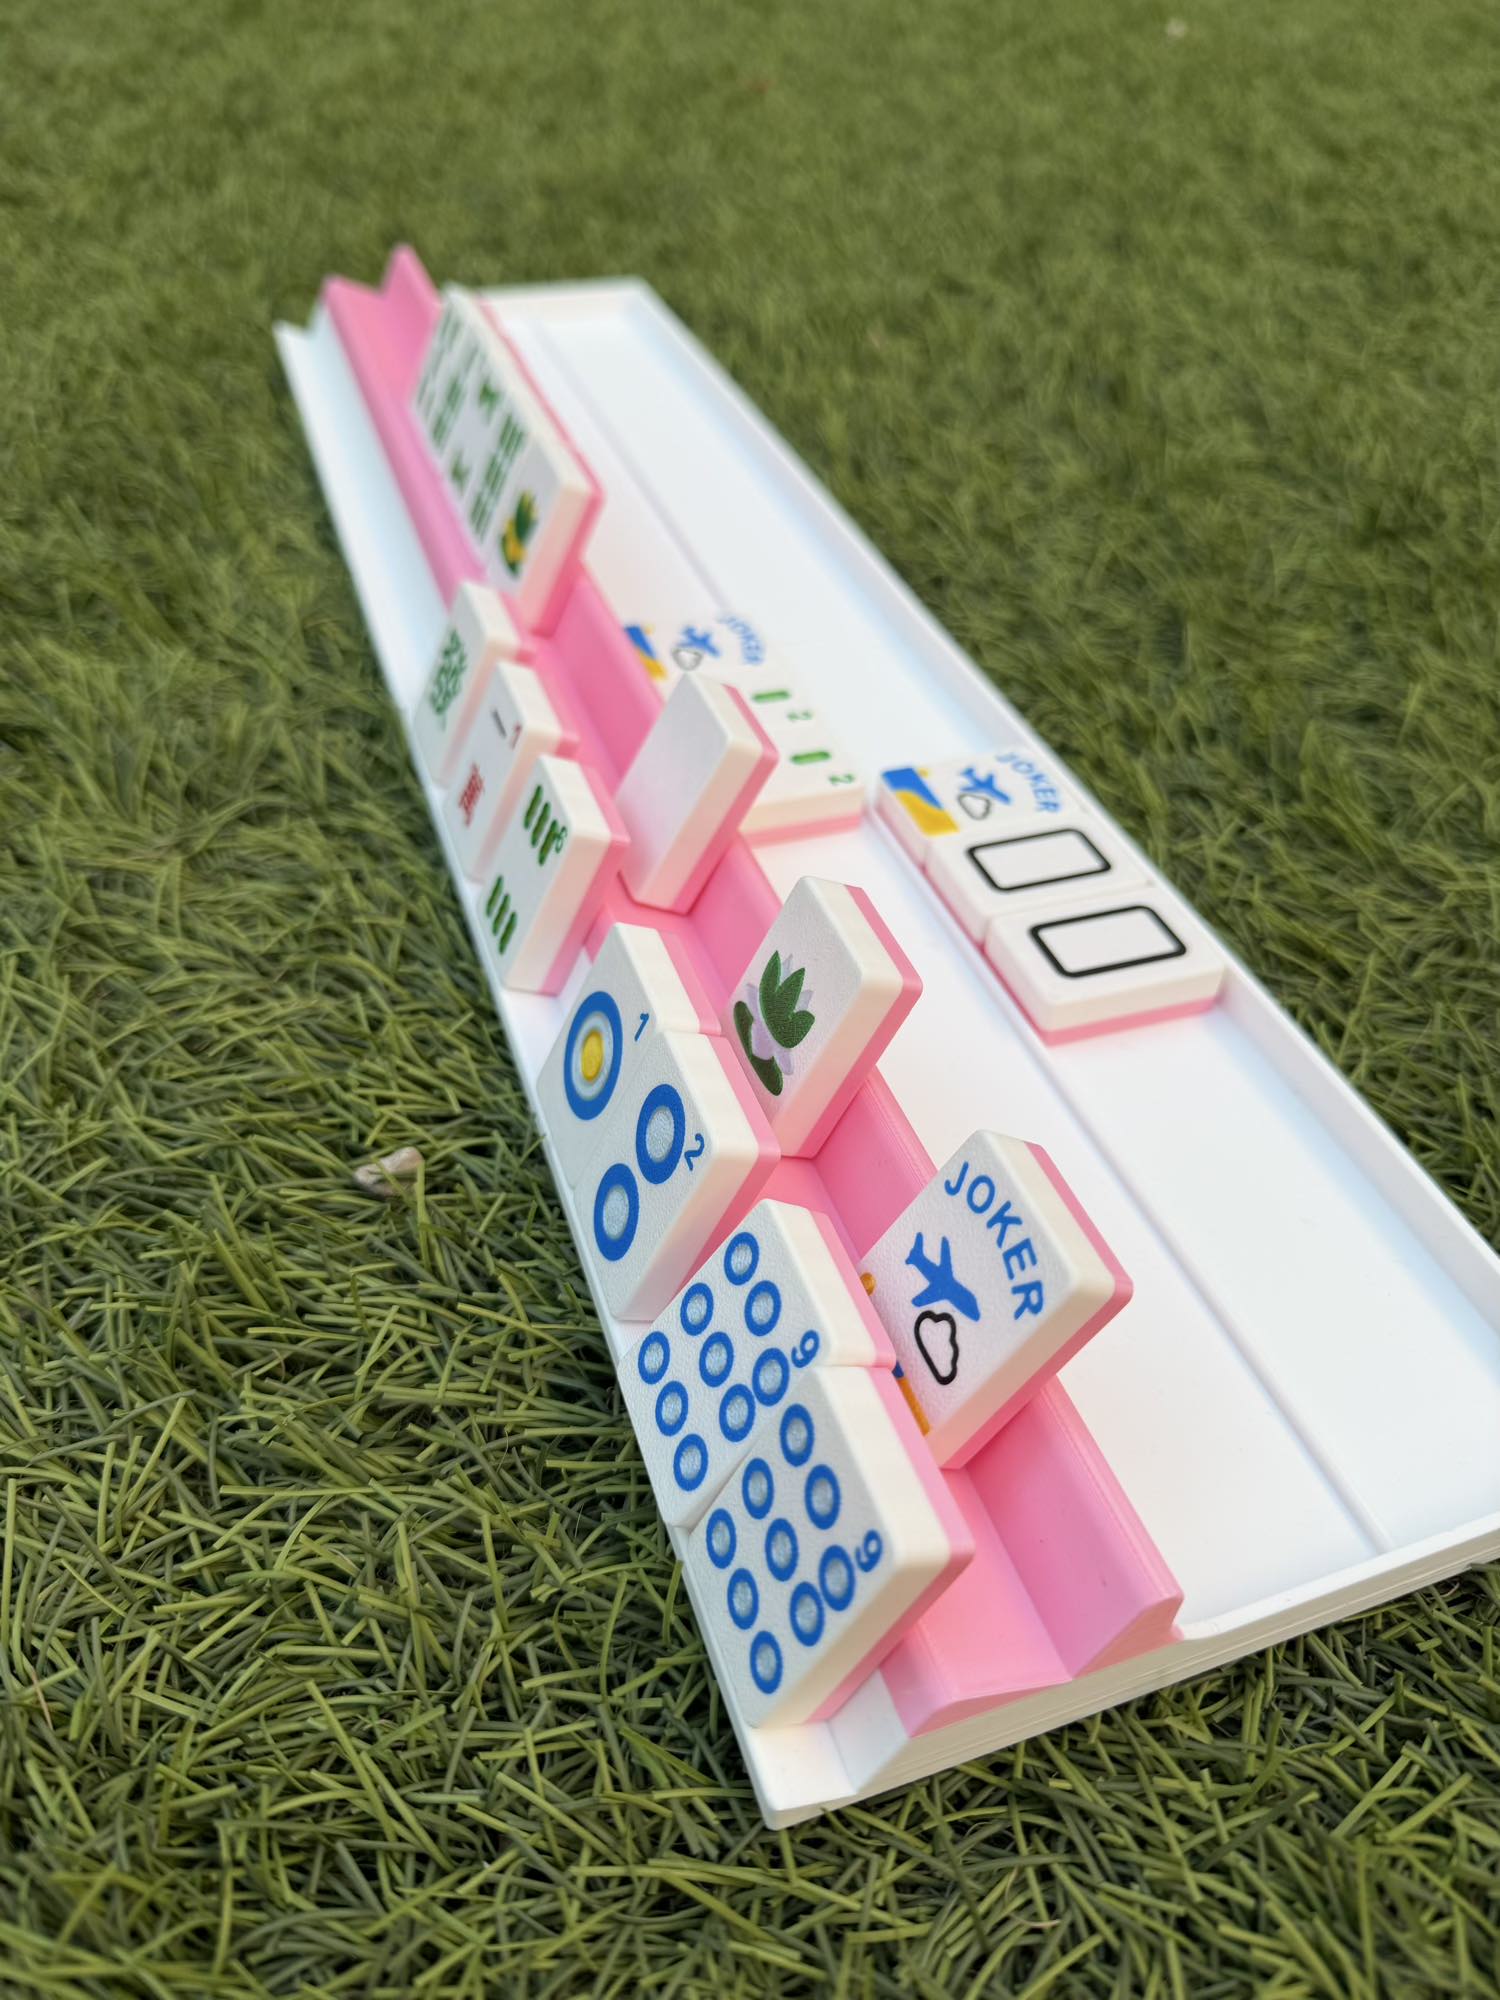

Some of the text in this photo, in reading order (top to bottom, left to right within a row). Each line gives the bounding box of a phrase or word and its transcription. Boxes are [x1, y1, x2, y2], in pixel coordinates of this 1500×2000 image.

[996, 752, 1061, 813] JOKER
[634, 1013, 649, 1042] 1
[684, 1133, 705, 1171] 2
[944, 1161, 1045, 1320] JOKER
[791, 1329, 820, 1368] 9
[855, 1528, 883, 1573] 9
